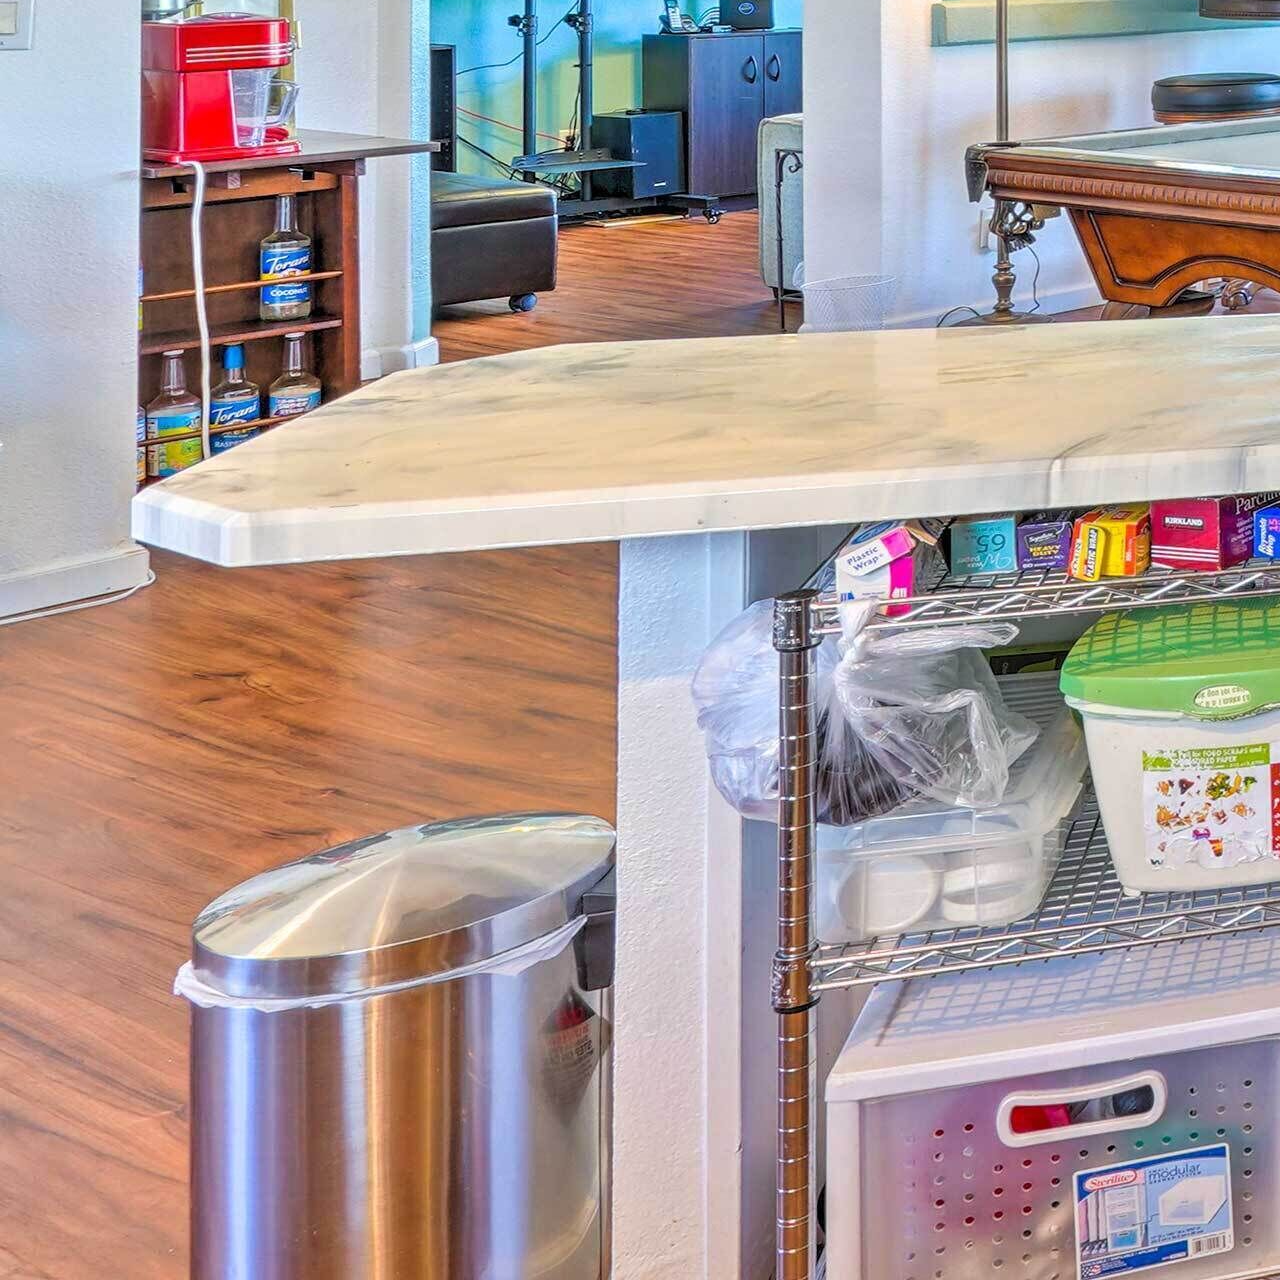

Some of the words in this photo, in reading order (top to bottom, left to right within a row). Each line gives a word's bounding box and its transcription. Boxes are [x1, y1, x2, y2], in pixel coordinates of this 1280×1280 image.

[266, 252, 310, 275] Torani
[212, 400, 259, 424] Torani
[1164, 516, 1204, 526] KIRKLAND
[977, 533, 1006, 554] 65
[1088, 528, 1098, 549] WRAP
[847, 546, 879, 565] Plastic
[1029, 544, 1061, 553] HEAVY
[1032, 549, 1060, 558] DUTY
[853, 555, 879, 571] Wrap
[1086, 550, 1097, 578] PLASTIC
[1089, 1170, 1134, 1188] Sterilite
[1148, 1163, 1201, 1181] modular
